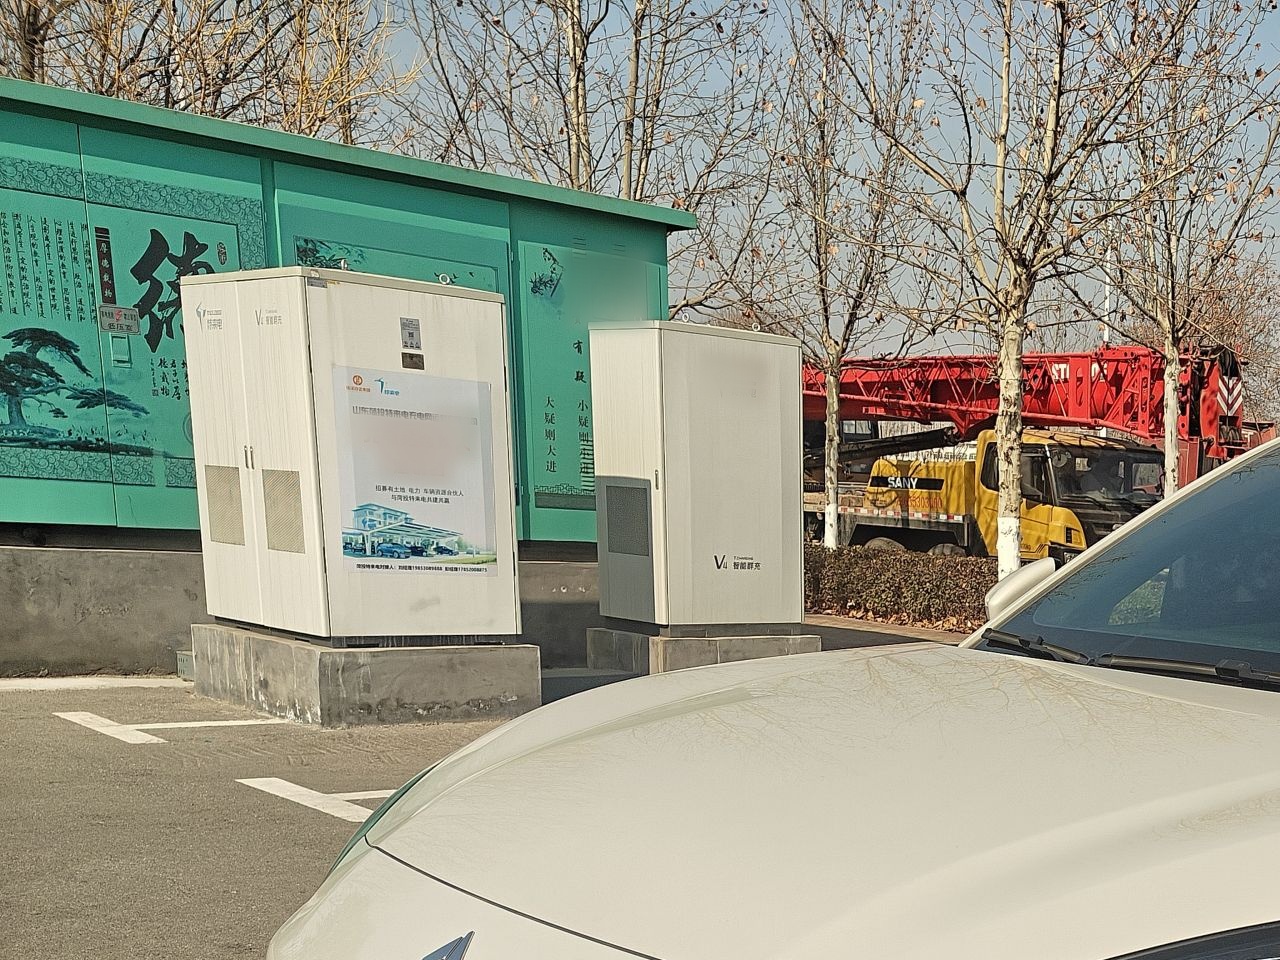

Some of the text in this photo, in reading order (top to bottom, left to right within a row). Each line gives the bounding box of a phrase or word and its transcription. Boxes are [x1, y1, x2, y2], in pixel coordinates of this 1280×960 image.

[544, 396, 557, 473] 大疑则大进
[887, 476, 919, 489] SANY
